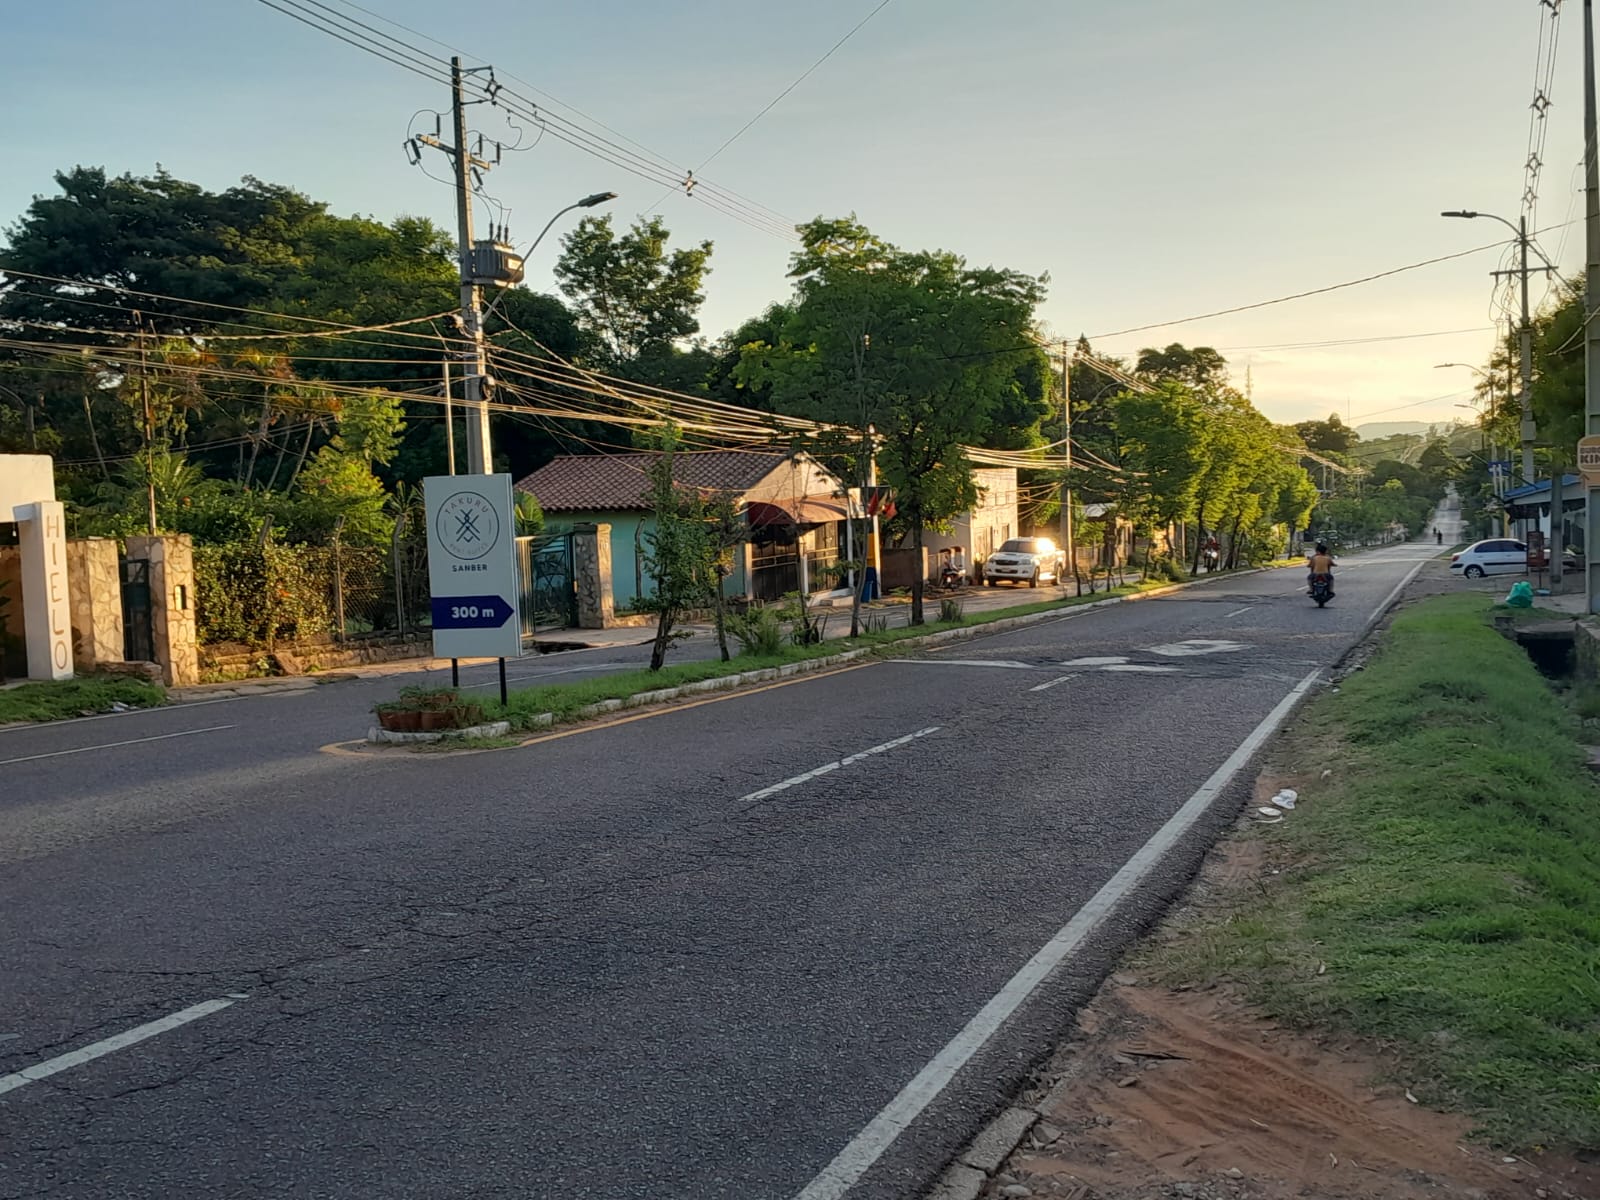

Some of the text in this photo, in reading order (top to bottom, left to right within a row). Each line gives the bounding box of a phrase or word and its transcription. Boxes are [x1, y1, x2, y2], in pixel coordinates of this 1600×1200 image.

[445, 497, 489, 514] TAKURU
[452, 564, 488, 573] SANBER
[46, 514, 67, 670] HIELO
[451, 606, 495, 619] 300 m
